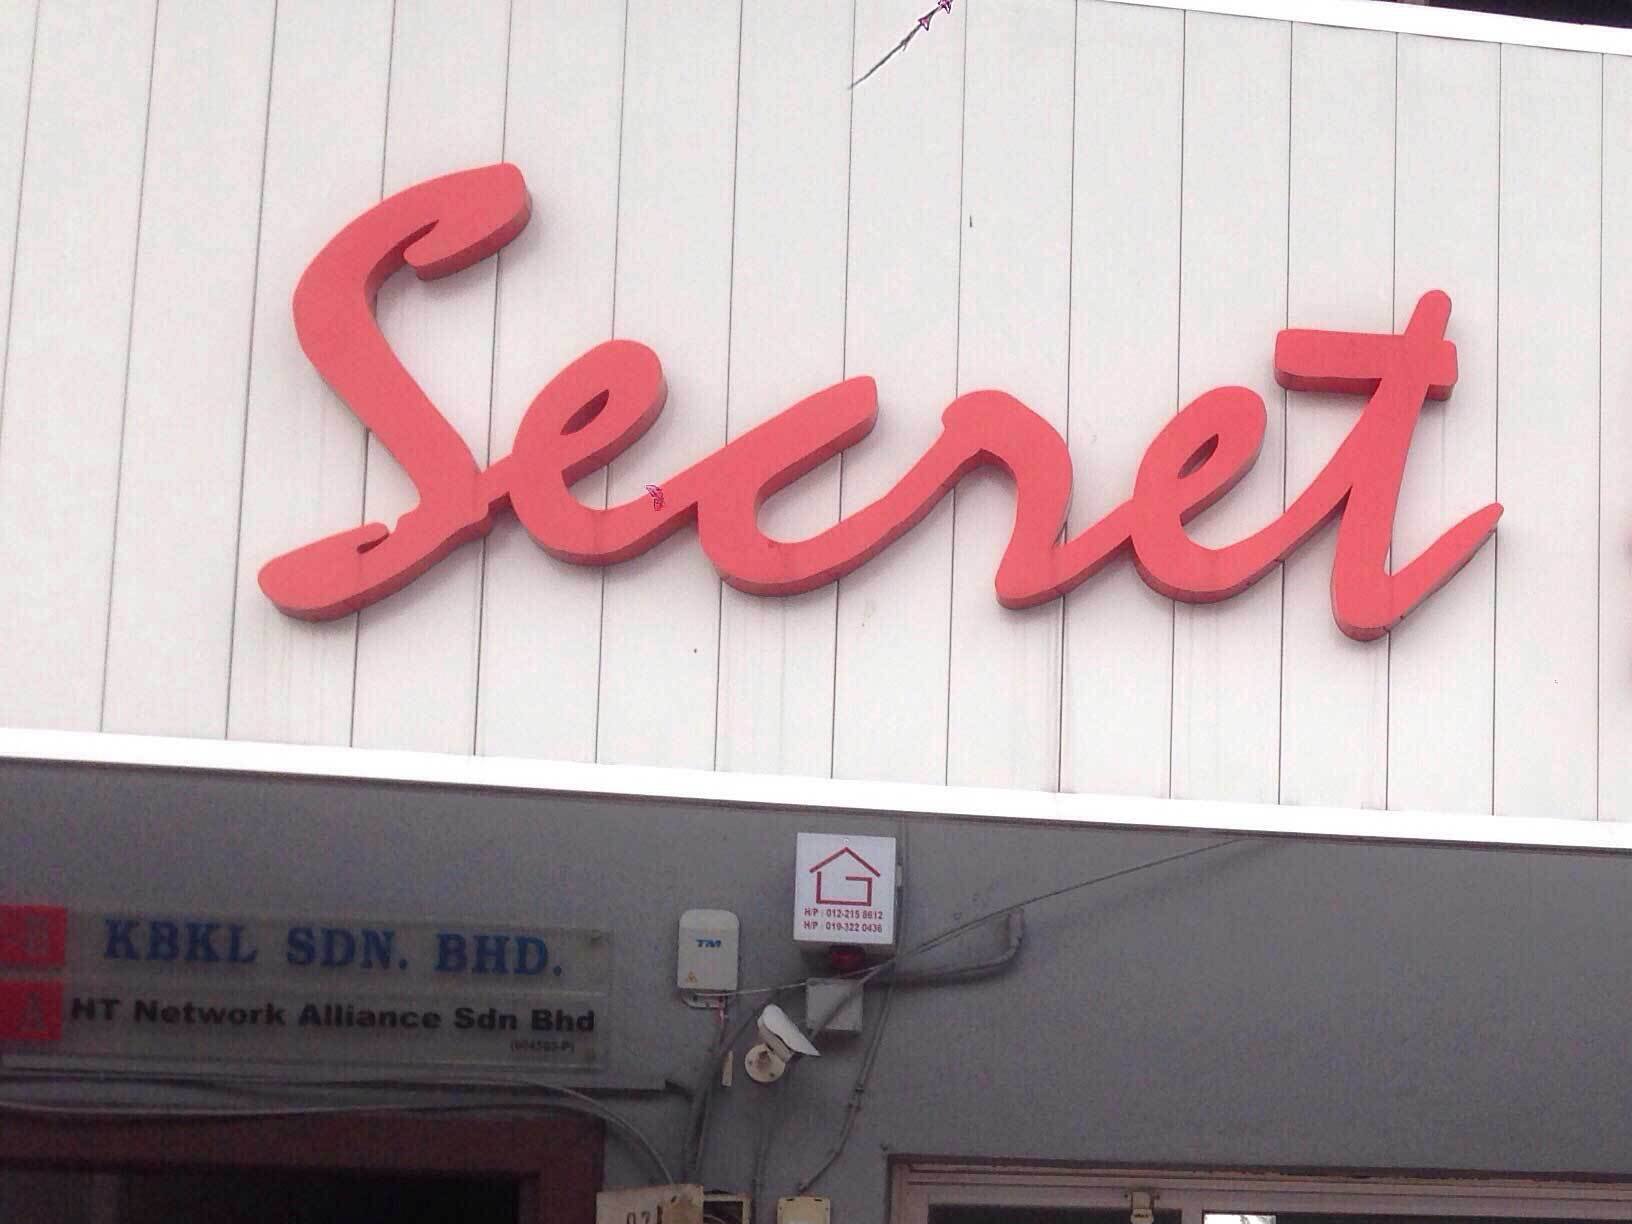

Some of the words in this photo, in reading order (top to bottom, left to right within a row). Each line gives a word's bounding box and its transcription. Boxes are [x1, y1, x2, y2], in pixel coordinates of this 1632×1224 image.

[260, 163, 1501, 640] Secret
[104, 918, 257, 964] KBKL
[287, 926, 408, 970] SDN.
[434, 932, 562, 976] BHD.
[72, 998, 119, 1021] HT
[133, 1000, 286, 1027] Network
[299, 1003, 442, 1030] Alliance
[455, 1006, 518, 1031] Sdn
[531, 1009, 595, 1033] Bhd
